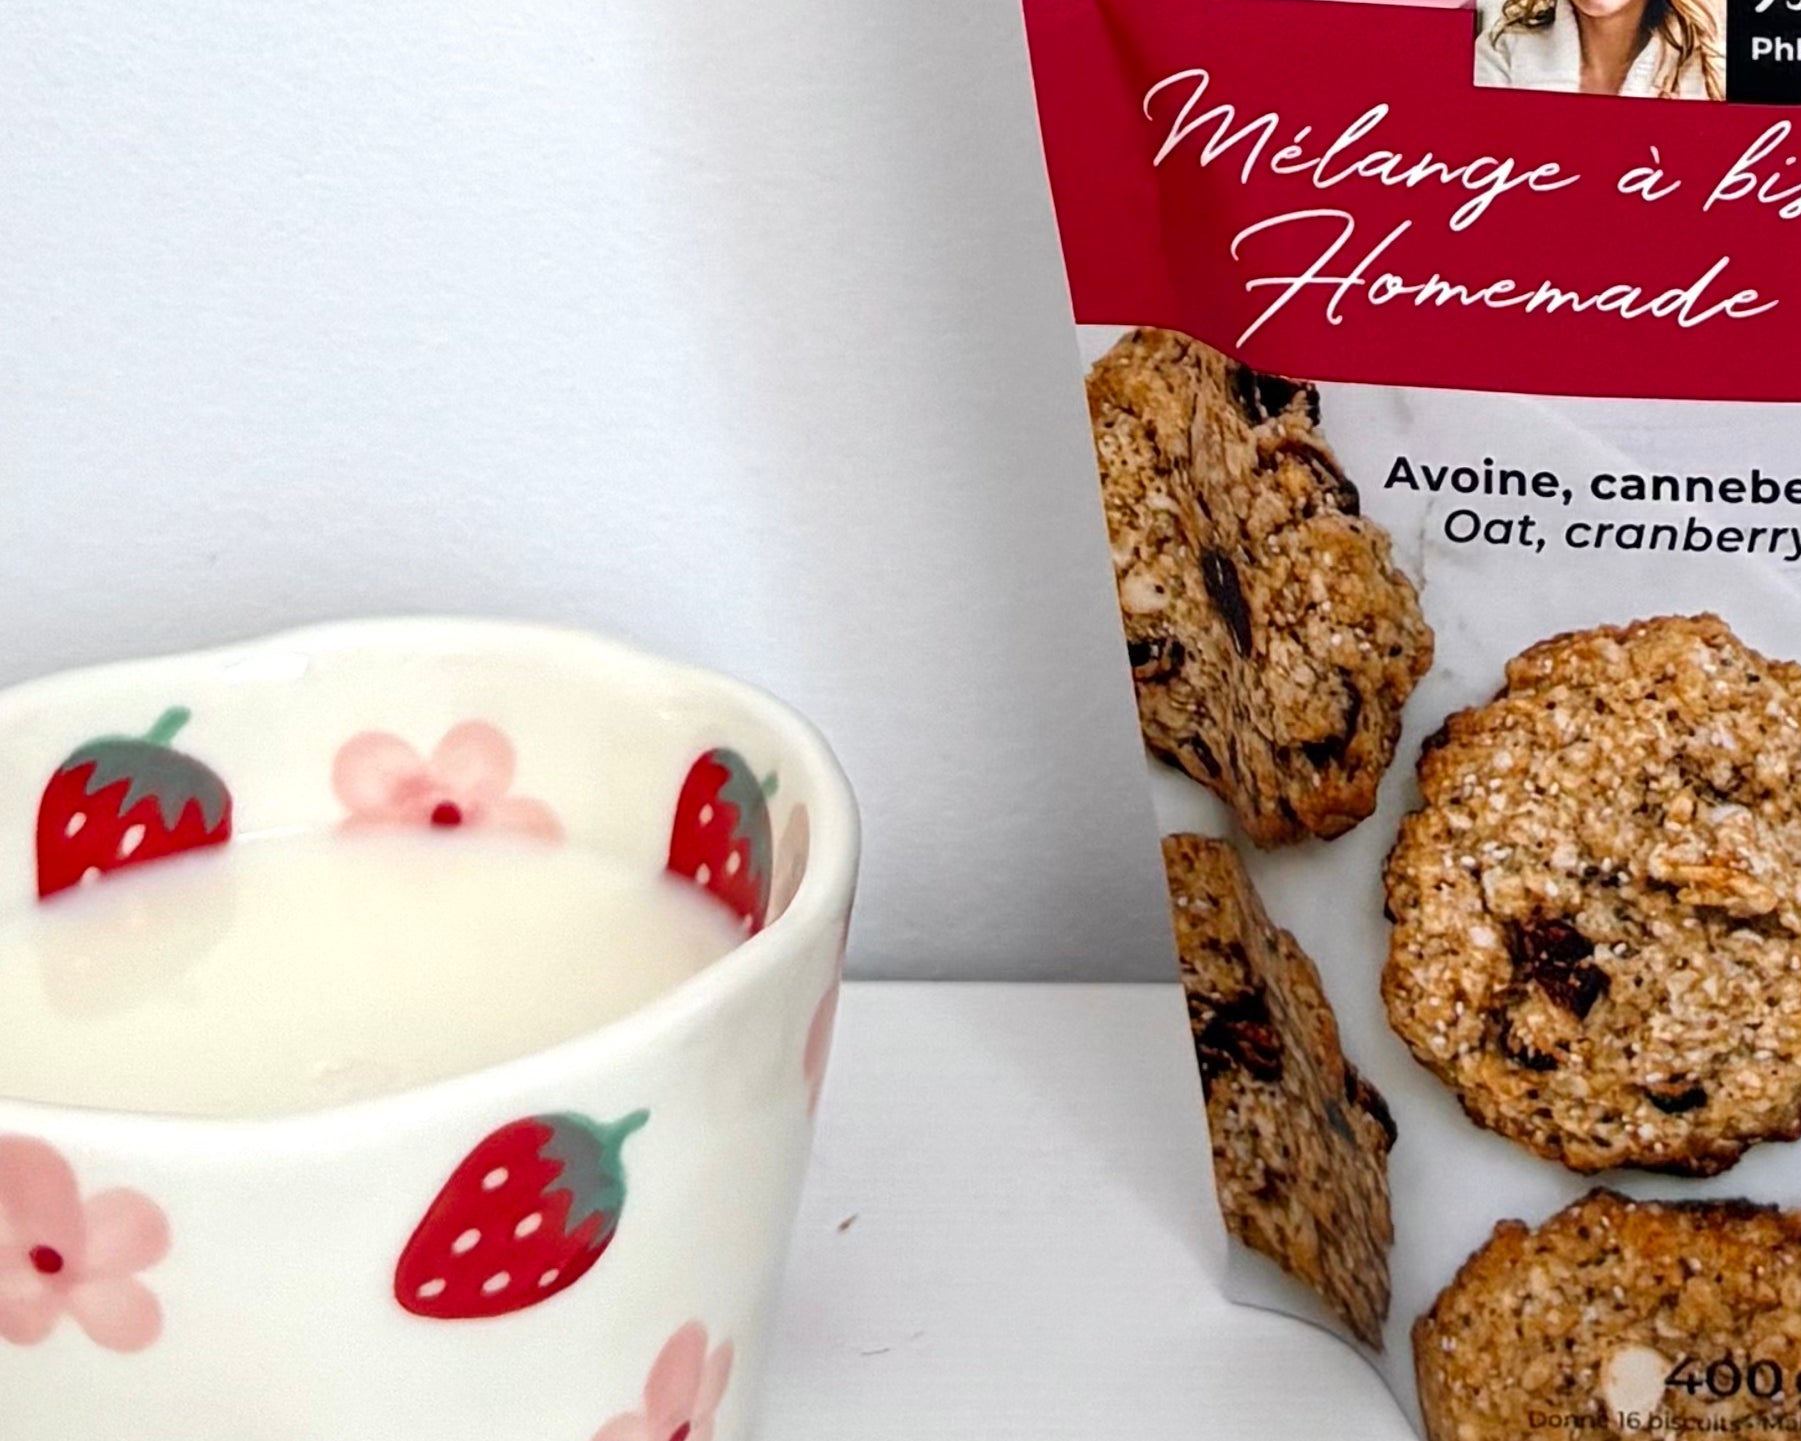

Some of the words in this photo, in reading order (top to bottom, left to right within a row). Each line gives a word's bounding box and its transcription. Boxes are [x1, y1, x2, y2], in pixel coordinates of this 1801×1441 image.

[1142, 68, 1581, 231] Mélange
[1616, 146, 1682, 202] à
[1230, 208, 1779, 348] Homemade
[1384, 456, 1573, 506] Avoine,
[1444, 509, 1546, 553] Oat,
[1664, 1357, 1783, 1397] 400
[1618, 1411, 1641, 1429] 16
